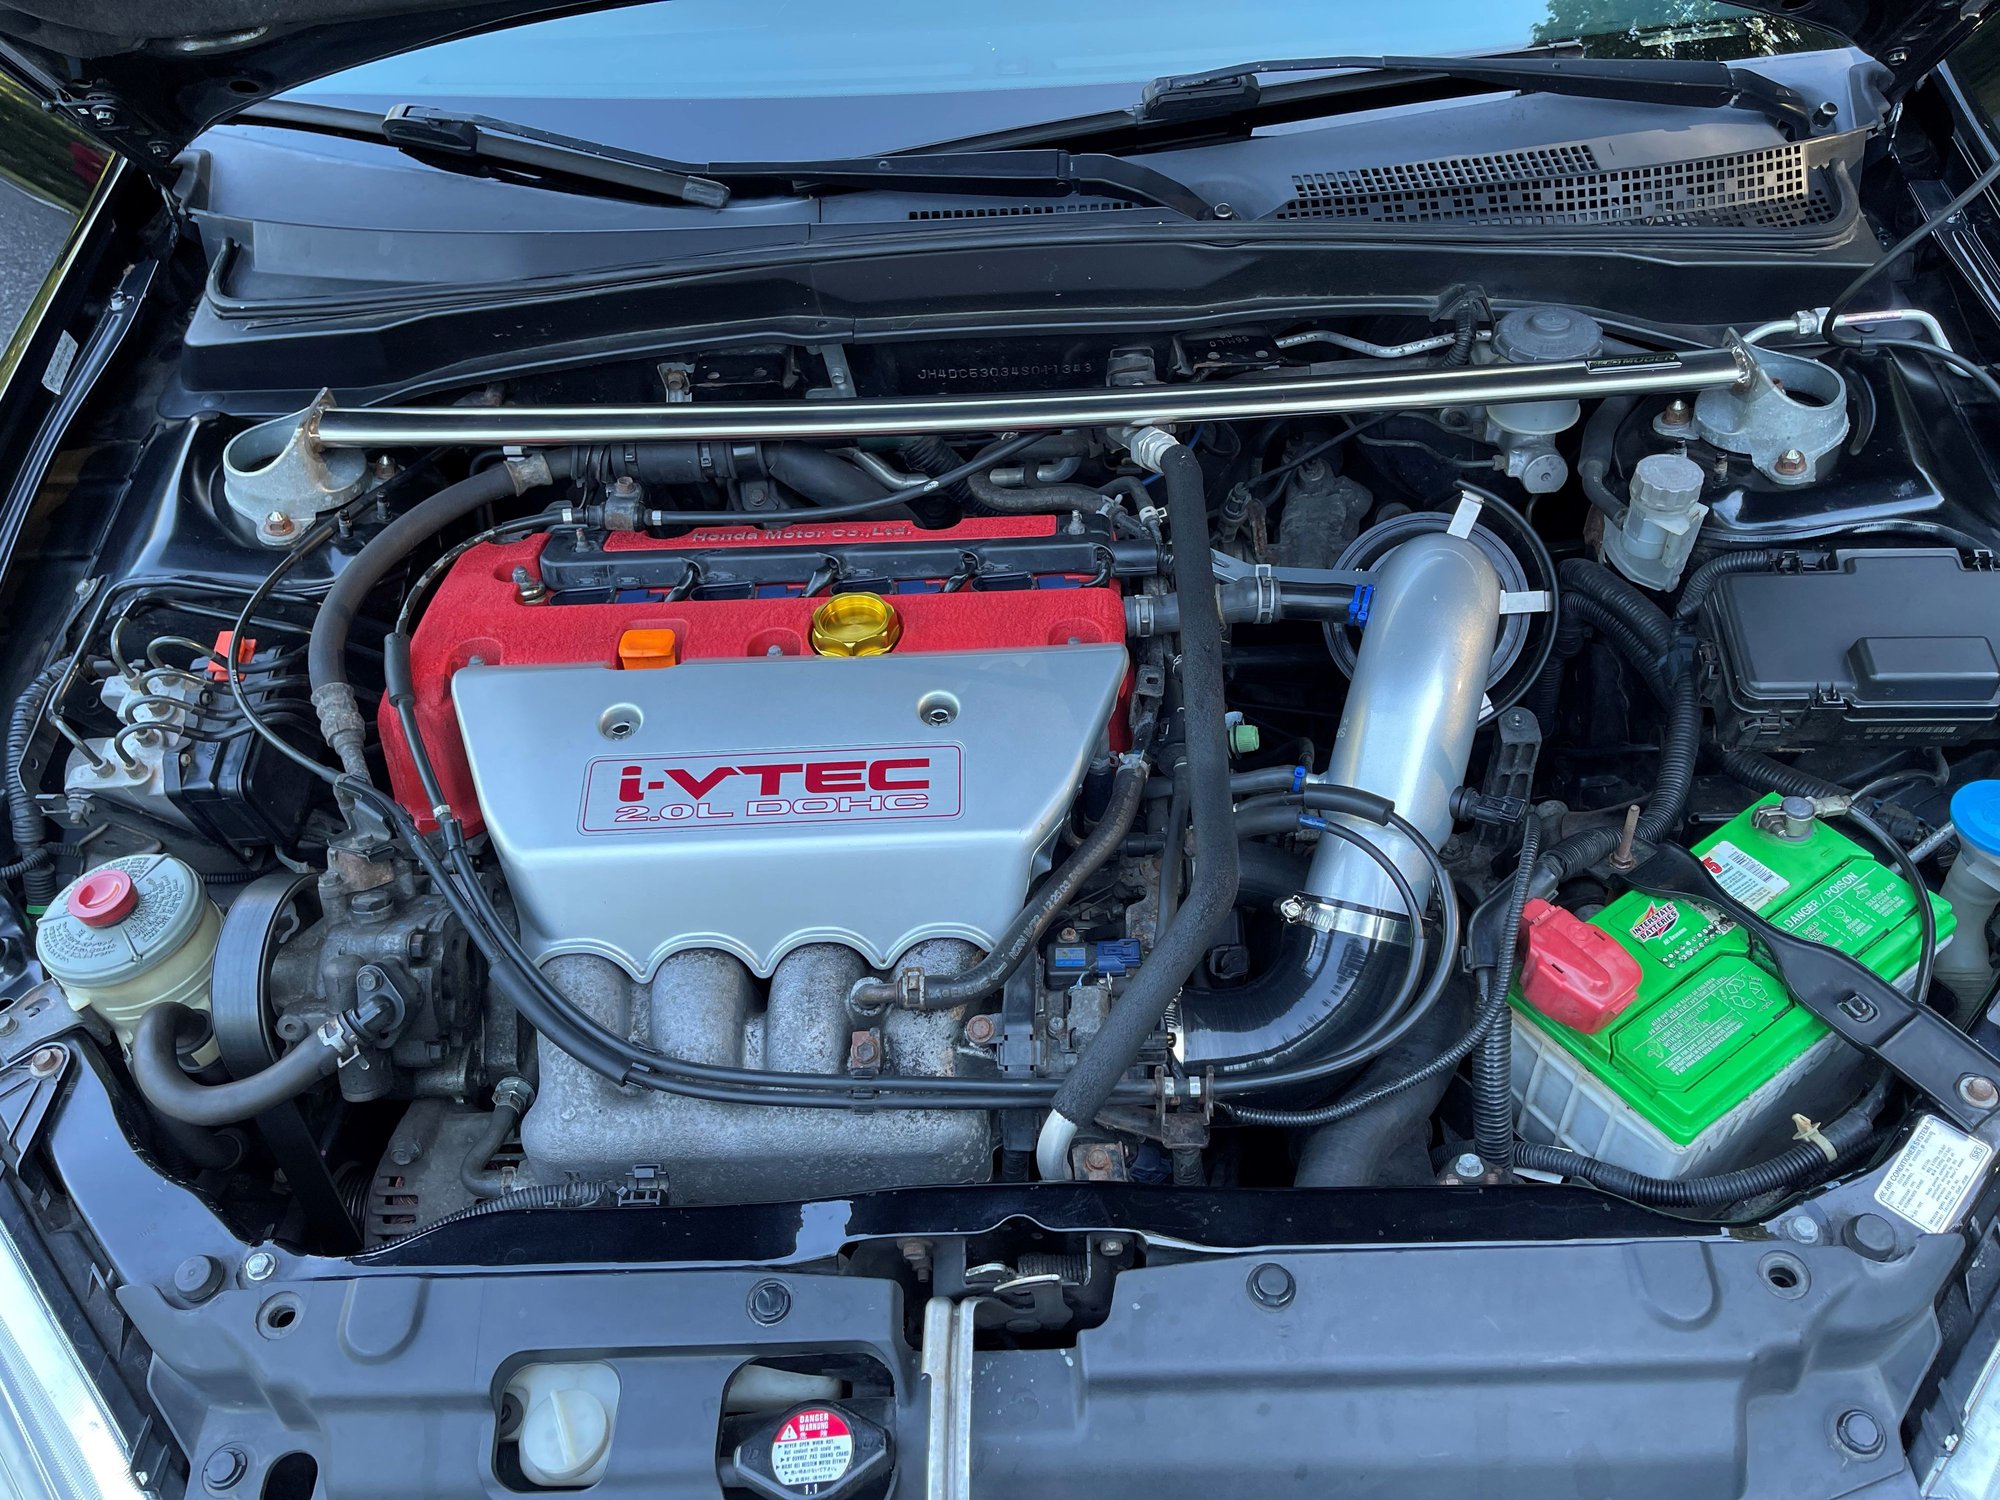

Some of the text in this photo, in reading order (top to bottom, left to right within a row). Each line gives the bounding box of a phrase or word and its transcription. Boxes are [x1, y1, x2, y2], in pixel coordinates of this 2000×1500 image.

[692, 531, 758, 542] Honda
[764, 528, 824, 540] Motor
[618, 757, 930, 802] i-VTEC
[614, 794, 929, 823] 2.0L DOHC
[1783, 899, 1821, 928] DANGER
[1824, 872, 1858, 898] POISON
[1632, 903, 1673, 935] INTERSTATE
[1640, 911, 1677, 940] BATTERIES
[1885, 1180, 1894, 1192] AIR
[1890, 1144, 1917, 1181] CONDITIONER
[1915, 1125, 1930, 1146] SYSTEM
[800, 1413, 828, 1423] DANGER
[800, 1421, 828, 1431] WARNUNG
[805, 1484, 817, 1495] 1.1
